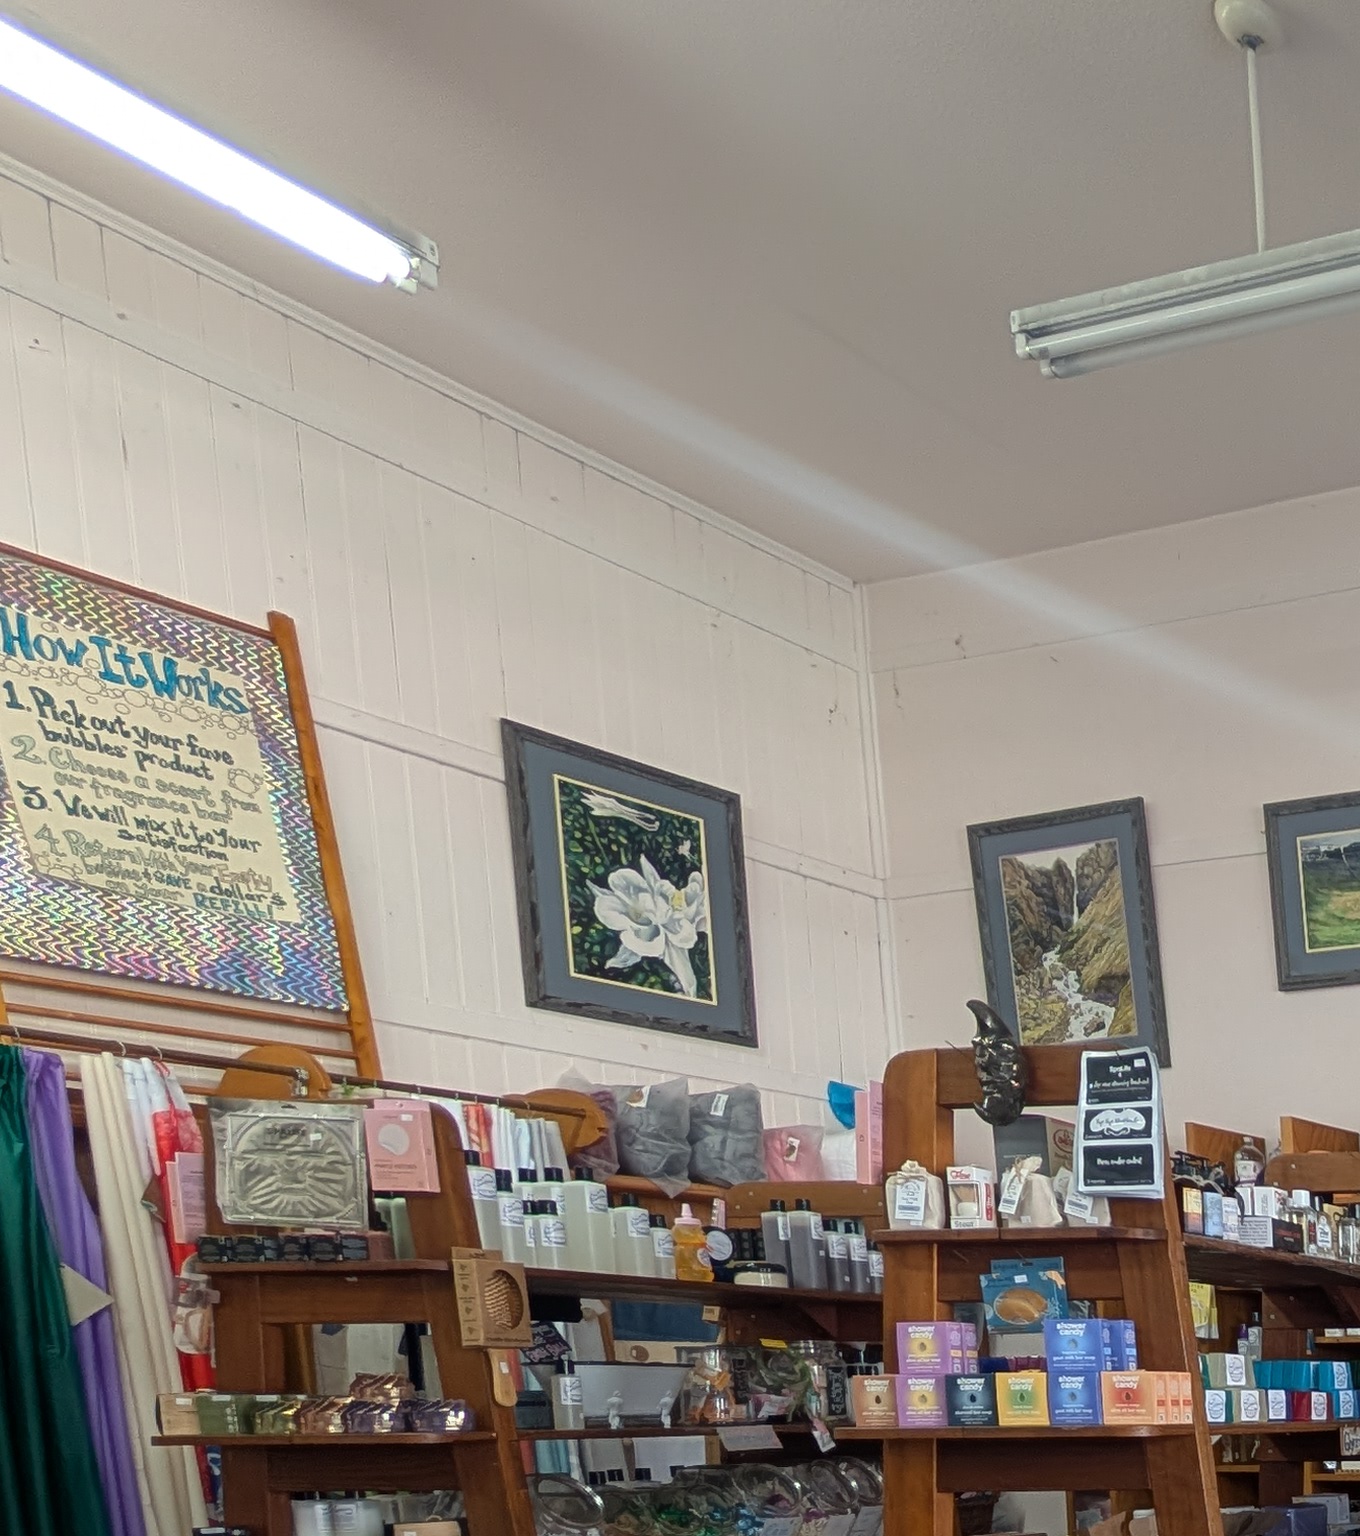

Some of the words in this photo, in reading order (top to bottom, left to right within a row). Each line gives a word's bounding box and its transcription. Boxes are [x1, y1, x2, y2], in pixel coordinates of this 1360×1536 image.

[0, 606, 90, 667] How
[89, 635, 148, 688] It
[138, 650, 250, 714] Works
[3, 680, 33, 712] 1.
[29, 686, 89, 731] Pick
[90, 715, 131, 738] out
[132, 725, 185, 749] your
[187, 733, 235, 765] fave
[49, 746, 130, 784] Choose
[135, 750, 214, 780] product
[53, 790, 93, 819] We
[94, 804, 130, 826] will
[133, 815, 169, 835] mix
[171, 817, 190, 840] it
[209, 877, 269, 902] dollar
[907, 1325, 935, 1333] shower
[1056, 1322, 1086, 1330] shower
[910, 1332, 934, 1340] candy
[1059, 1328, 1085, 1337] candy
[864, 1379, 890, 1387] shower
[908, 1377, 935, 1386] shower
[957, 1377, 985, 1385] shower
[1008, 1376, 1034, 1384] shower
[1058, 1375, 1085, 1383] shower
[1112, 1375, 1140, 1383] shower
[866, 1384, 888, 1393] candy
[910, 1383, 934, 1392] candy
[959, 1383, 984, 1392] candy
[1010, 1382, 1033, 1391] candy
[1061, 1381, 1084, 1390] candy
[1114, 1381, 1139, 1390] candy
